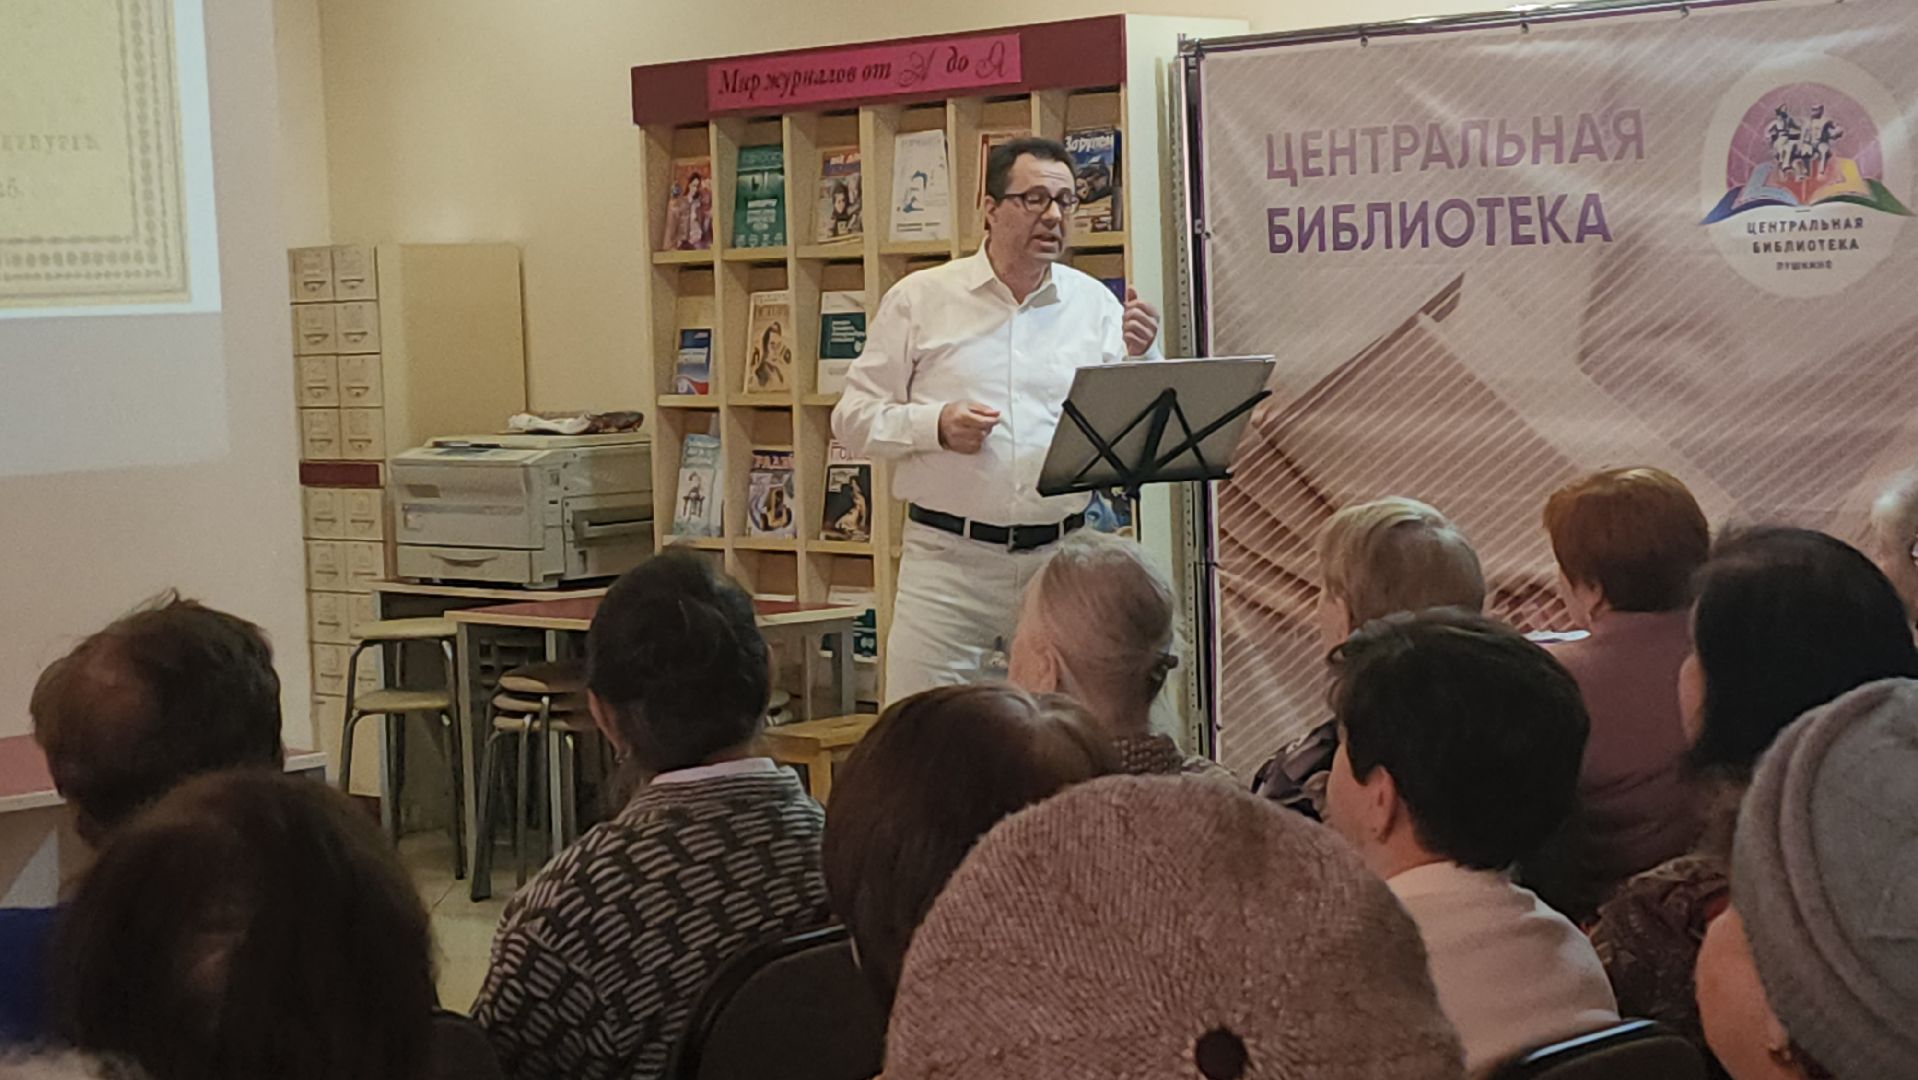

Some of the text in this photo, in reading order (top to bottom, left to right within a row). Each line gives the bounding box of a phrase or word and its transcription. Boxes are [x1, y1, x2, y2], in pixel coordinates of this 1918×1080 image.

[719, 69, 760, 99] Мир
[862, 62, 893, 81] от
[946, 46, 970, 73] до
[1266, 108, 1645, 187] ЦЕНТРАЛЬНАЯ
[1267, 193, 1613, 254] БИБЛИОТЕКА
[1746, 217, 1864, 235] ЦЕНТРАЛЬНАЯ
[1752, 238, 1859, 254] БИБЛИОТЕКА
